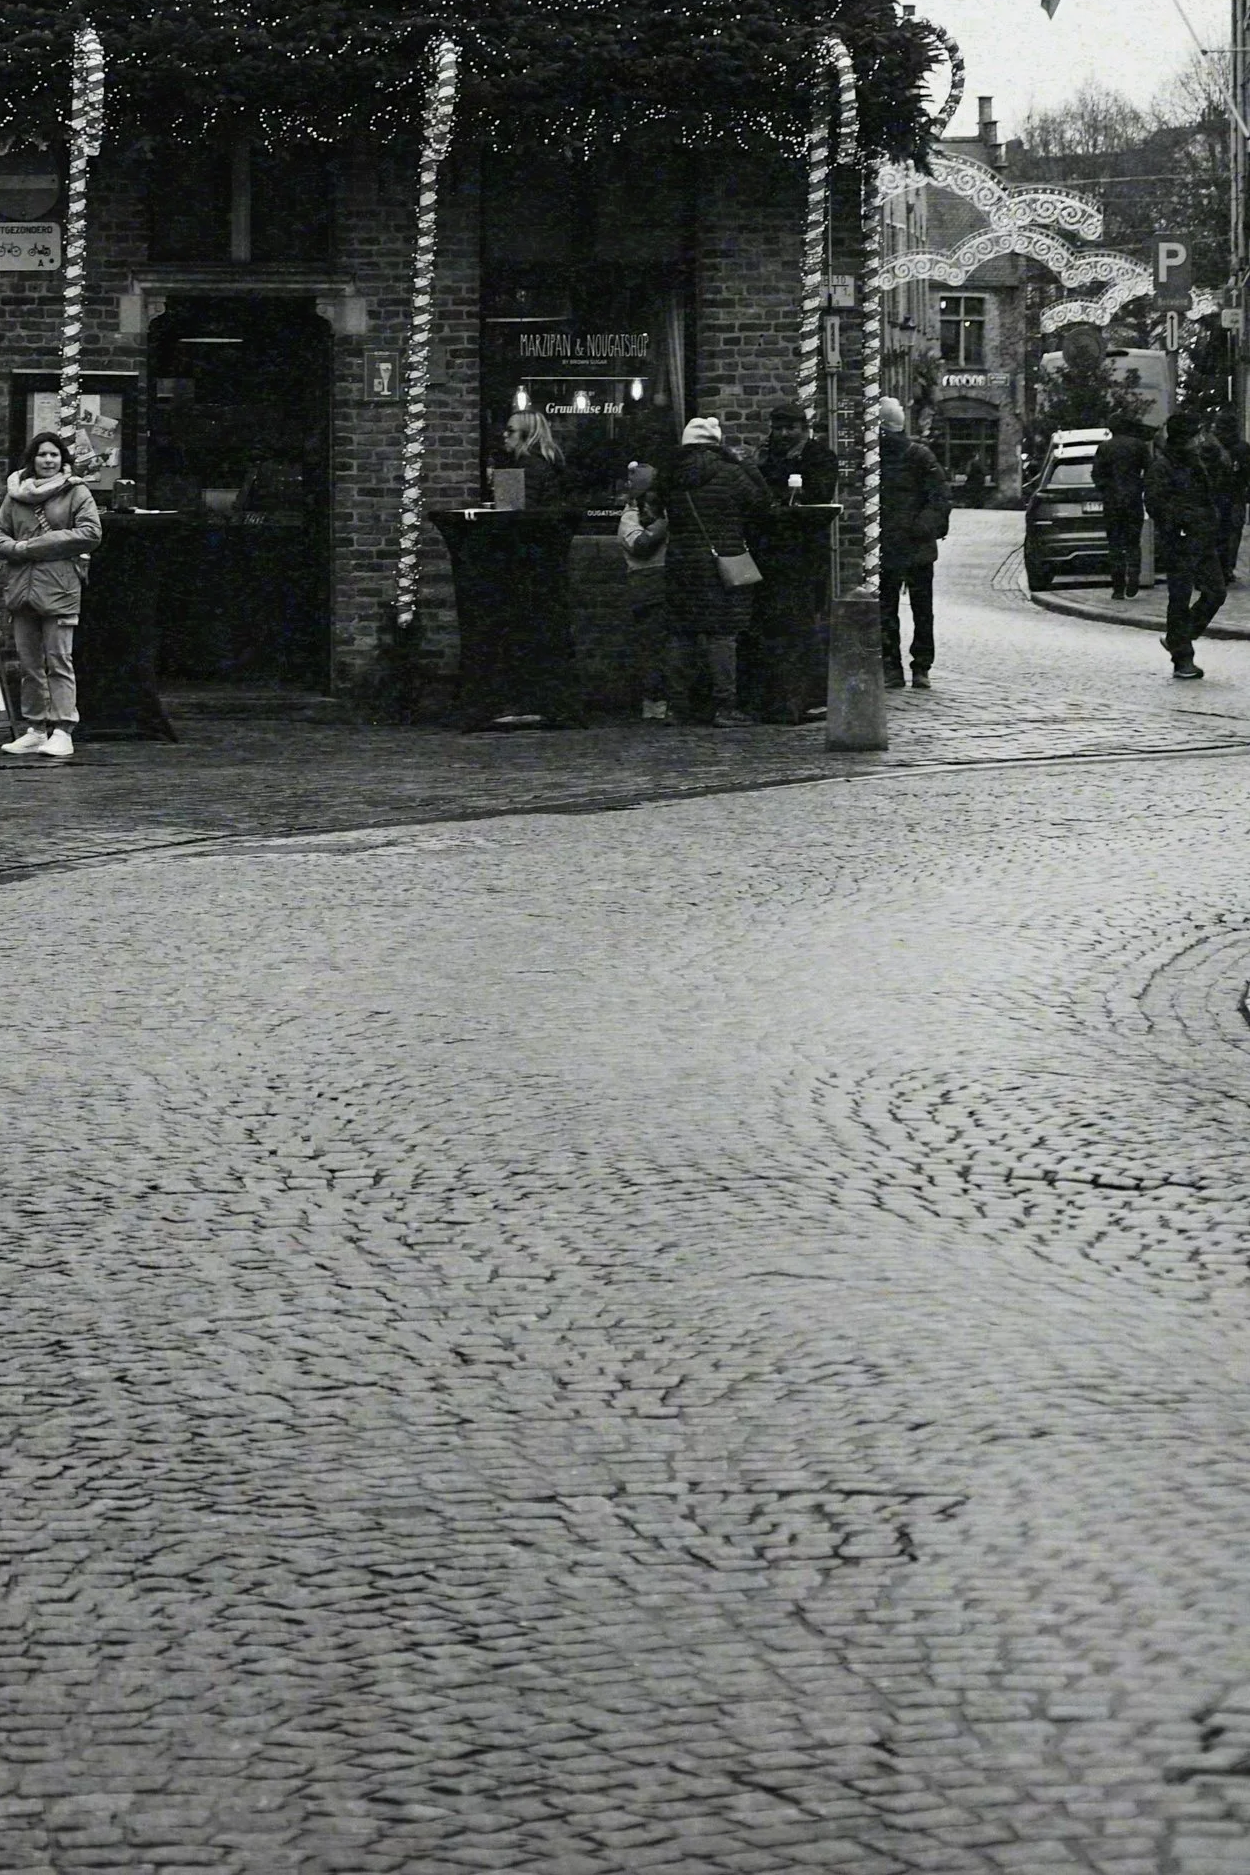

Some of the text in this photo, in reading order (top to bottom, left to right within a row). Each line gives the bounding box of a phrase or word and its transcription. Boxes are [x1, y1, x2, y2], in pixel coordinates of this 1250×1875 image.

[38, 259, 44, 267] A
[1158, 242, 1187, 283] P
[520, 333, 649, 357] MARZIPAN & NOUGATSHOP
[603, 403, 624, 414] Hof
